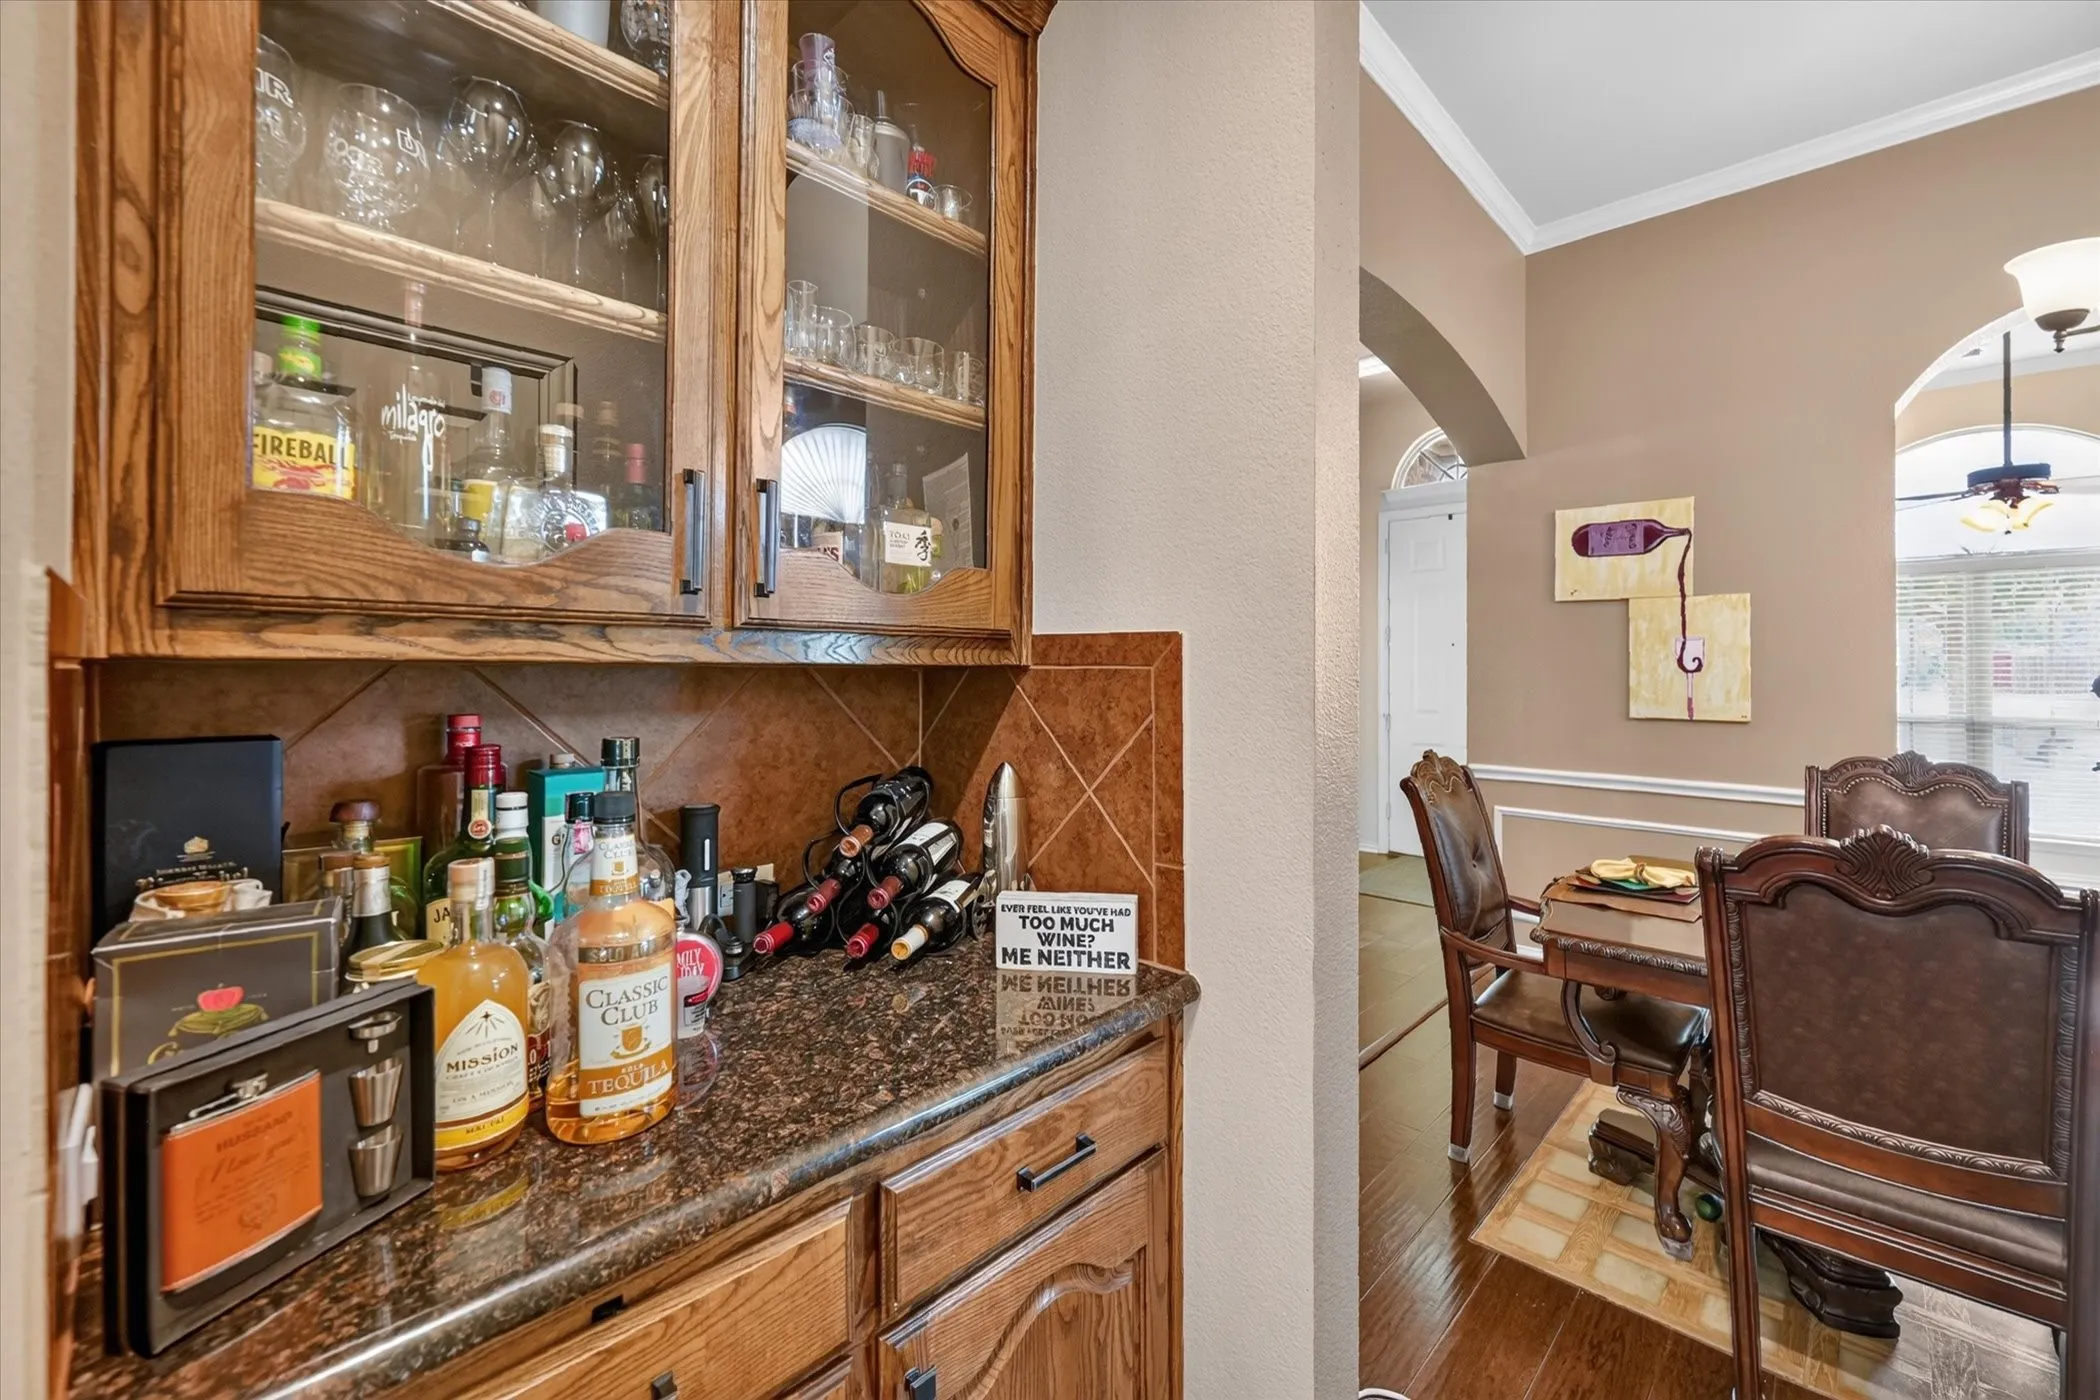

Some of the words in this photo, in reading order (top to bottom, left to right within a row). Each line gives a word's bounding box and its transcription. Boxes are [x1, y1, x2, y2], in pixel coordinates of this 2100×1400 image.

[381, 383, 446, 472] milagro
[1001, 904, 1025, 913] EVER
[1027, 904, 1048, 914] FEEL
[1052, 906, 1072, 914] LIKE
[1073, 907, 1108, 915] YOU'VE
[1111, 908, 1132, 917] HAD
[1019, 916, 1056, 930] TOO
[1060, 917, 1115, 932] MUCH
[1037, 932, 1096, 948] WINE?
[1001, 947, 1032, 965] ME
[1037, 949, 1131, 970] NEITHER
[585, 975, 669, 1009] CLASSIC
[600, 999, 658, 1026] CLUB
[587, 1059, 668, 1095] TEQUILA
